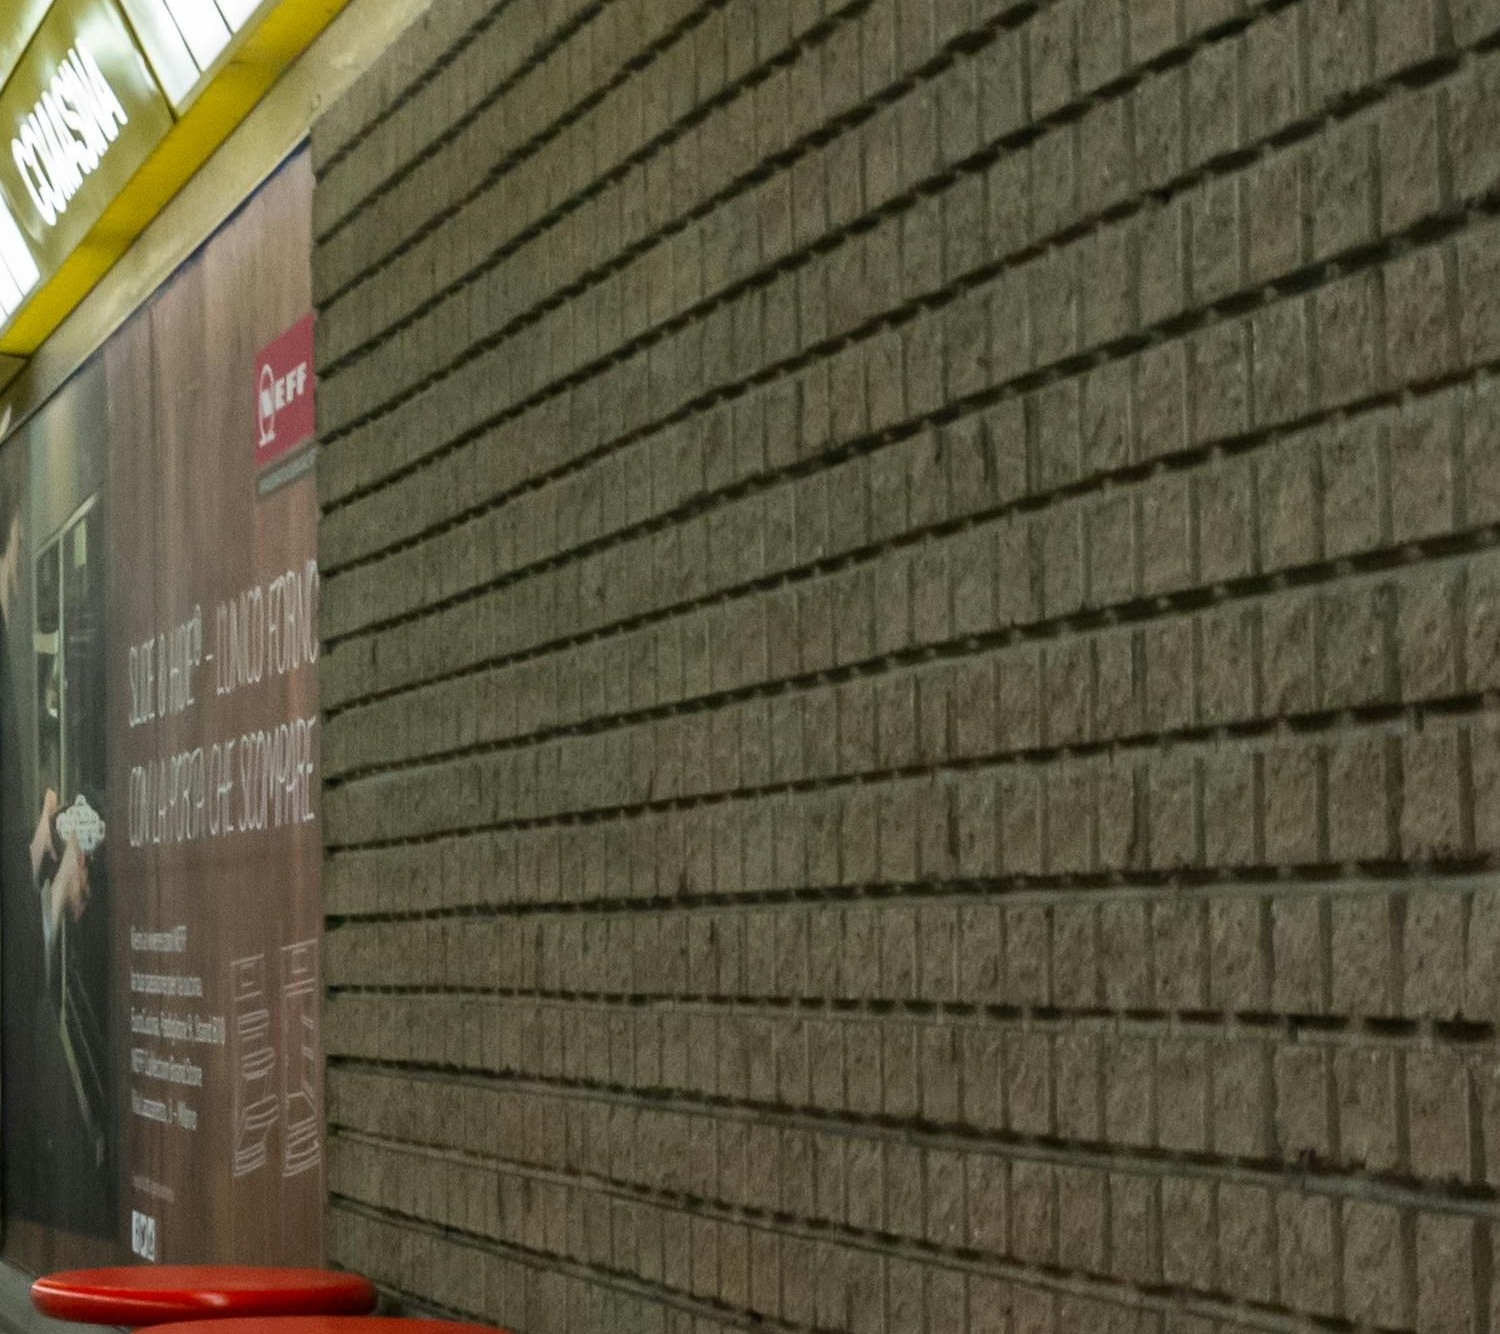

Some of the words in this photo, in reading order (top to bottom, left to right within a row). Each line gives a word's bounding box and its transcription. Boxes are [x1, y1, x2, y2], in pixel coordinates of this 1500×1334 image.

[11, 37, 128, 226] COMASINA
[260, 362, 307, 418] NEFF
[268, 559, 320, 675] FORNO
[209, 738, 235, 837] CHE
[238, 715, 316, 833] SCOMPARE
